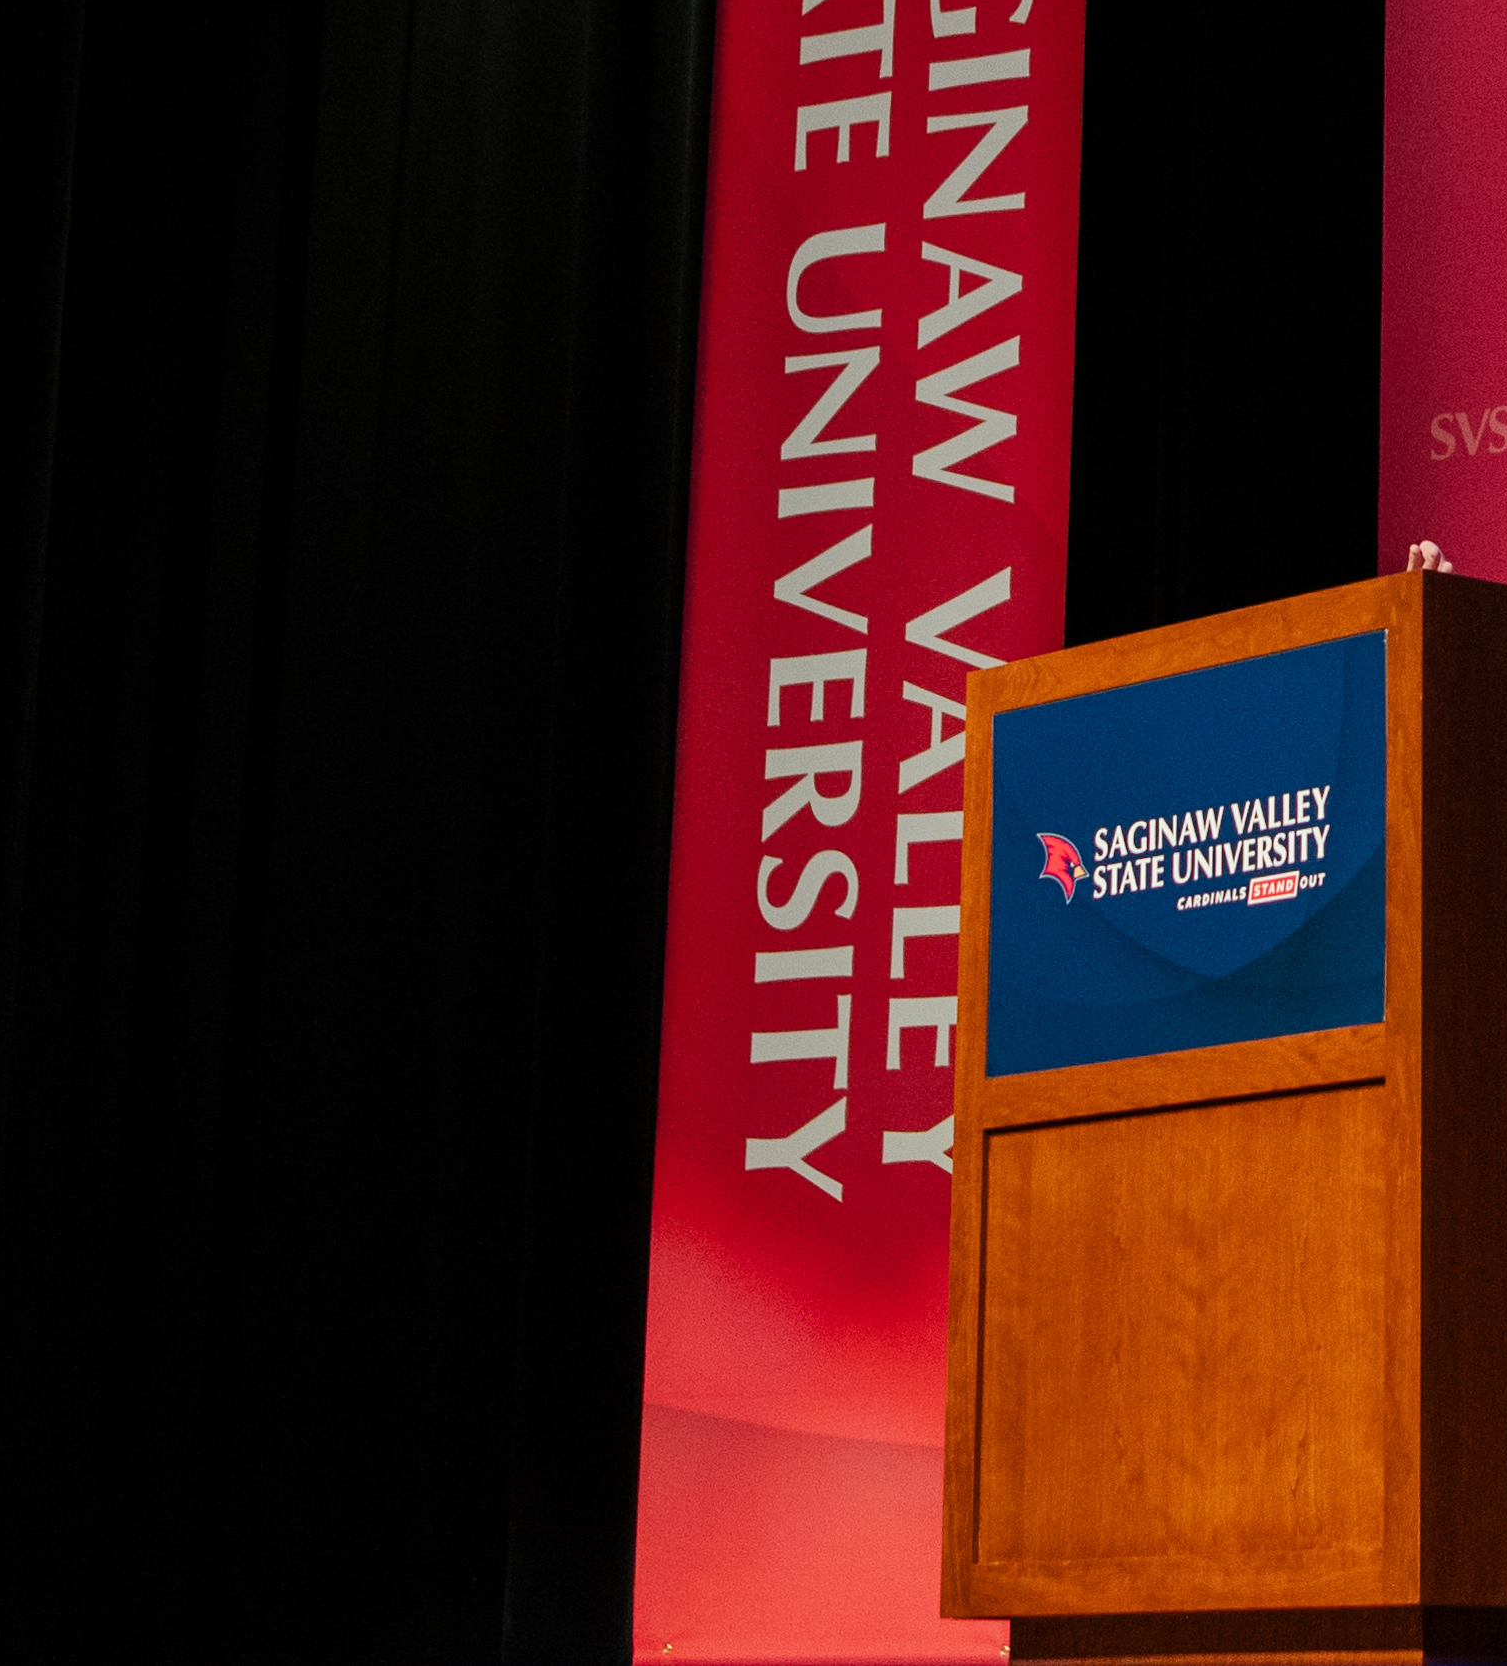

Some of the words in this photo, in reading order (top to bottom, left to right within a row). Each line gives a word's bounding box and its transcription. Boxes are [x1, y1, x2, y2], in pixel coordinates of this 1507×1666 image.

[744, 222, 887, 1202] UNIVERSITY
[1093, 854, 1165, 899] STATE
[1172, 824, 1330, 884] UNIVERSITY
[1094, 805, 1225, 862] SAGINAW
[1230, 785, 1331, 835] VALLEY
[881, 566, 1011, 1175] VALLEY
[1177, 886, 1247, 911] CARDINALS
[1253, 879, 1295, 899] STAND
[1299, 872, 1326, 890] OUT
